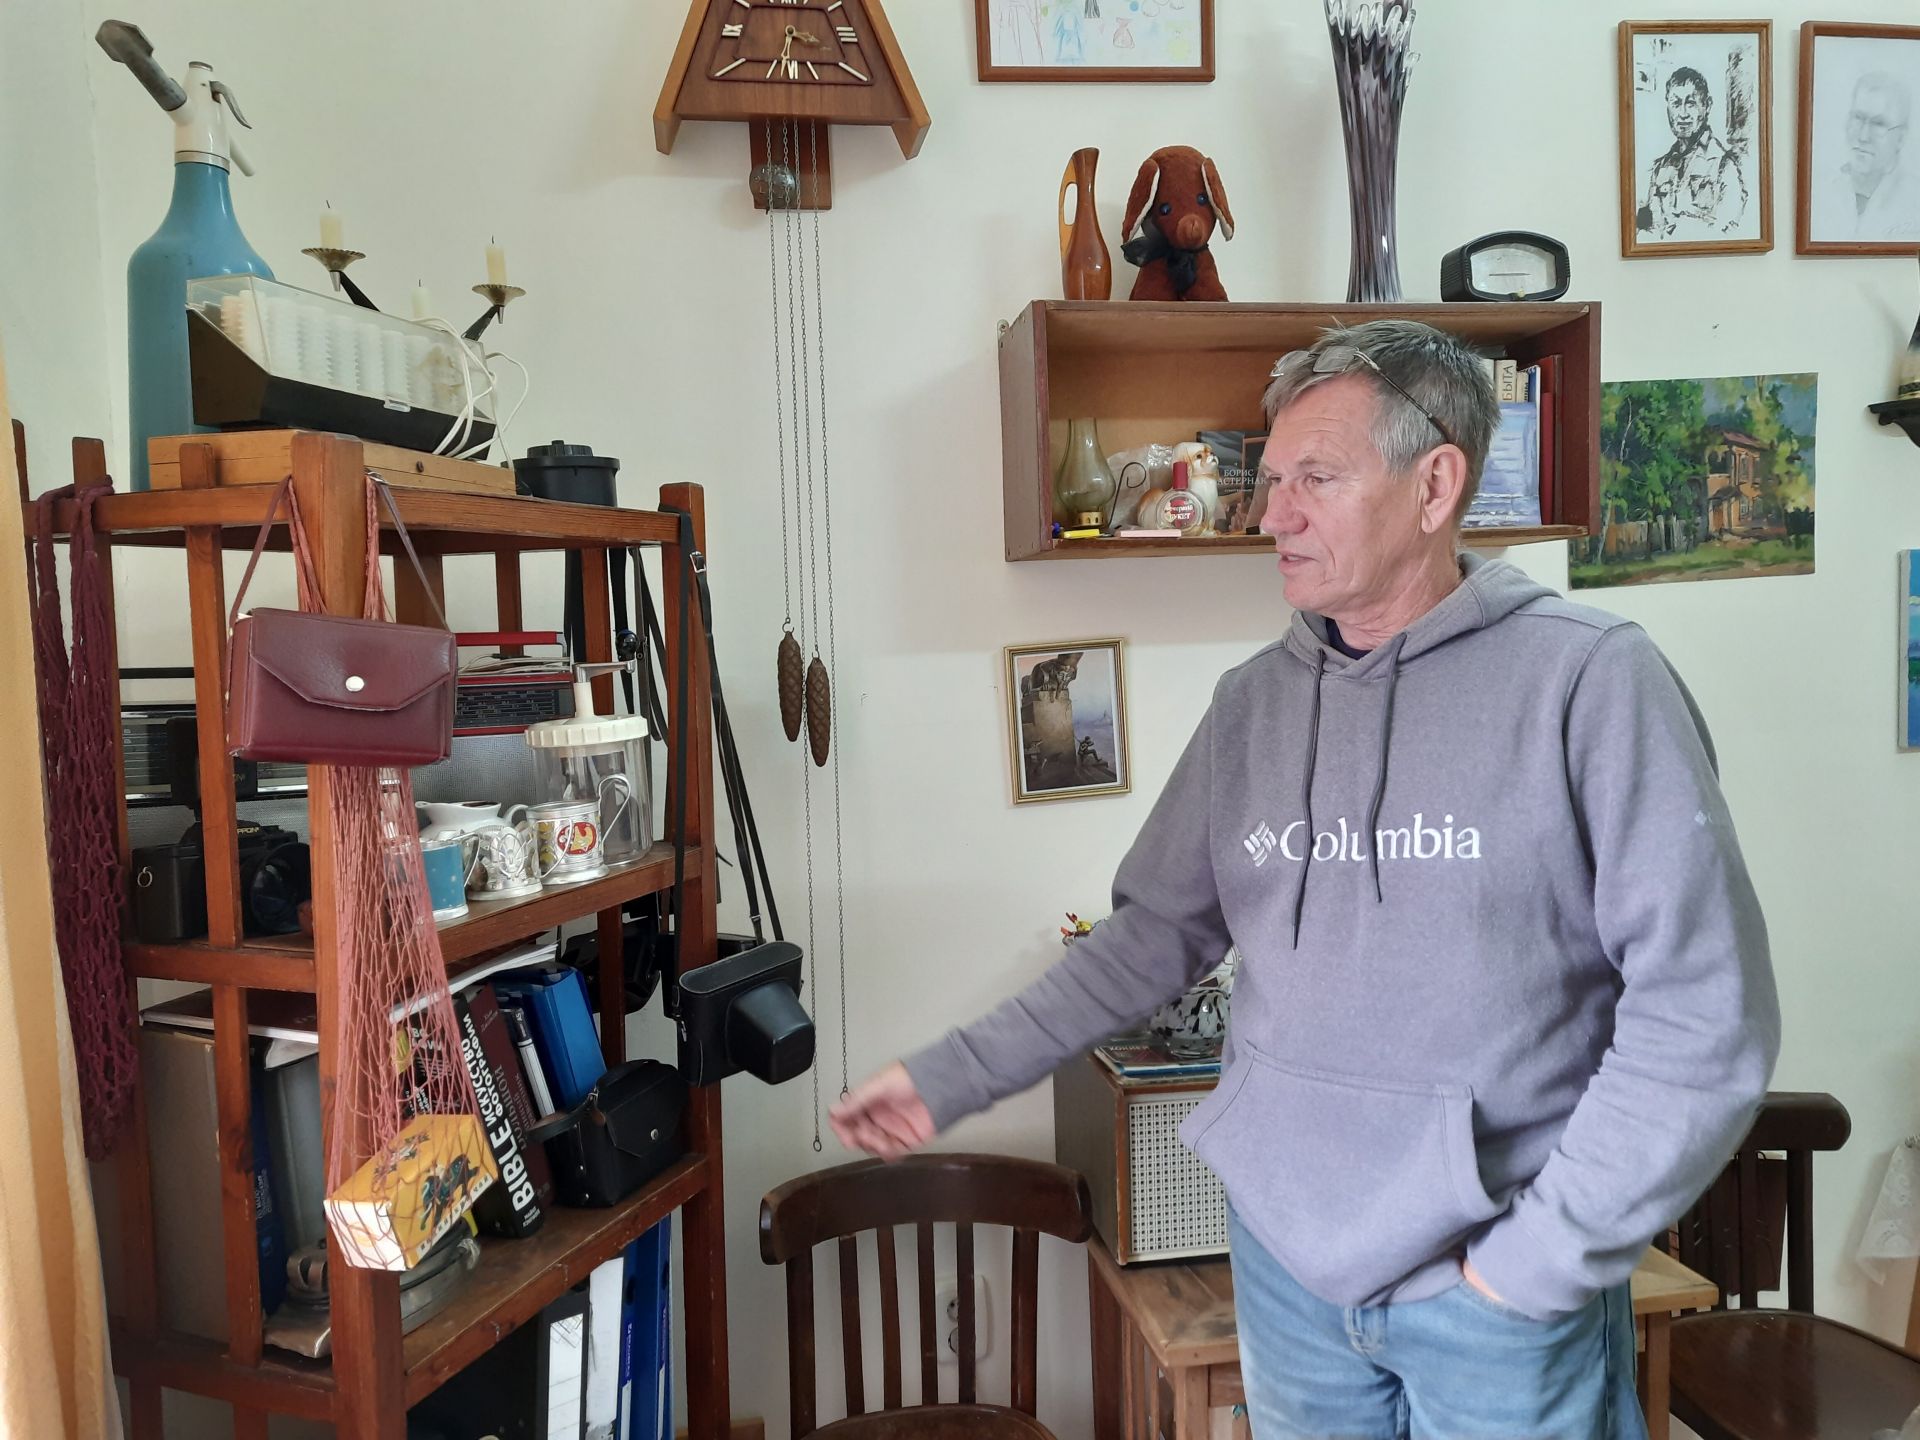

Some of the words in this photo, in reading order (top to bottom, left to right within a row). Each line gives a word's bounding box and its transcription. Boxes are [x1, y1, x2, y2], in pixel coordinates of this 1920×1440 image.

[1217, 477, 1267, 485] АСТЕРНАК
[1224, 469, 1254, 477] БОРИС
[1279, 812, 1482, 862] Columbia
[461, 1038, 498, 1127] ИСКУССТВО
[463, 1012, 504, 1118] ФОТОГРАФИИ
[490, 1118, 535, 1212] BIBLE
